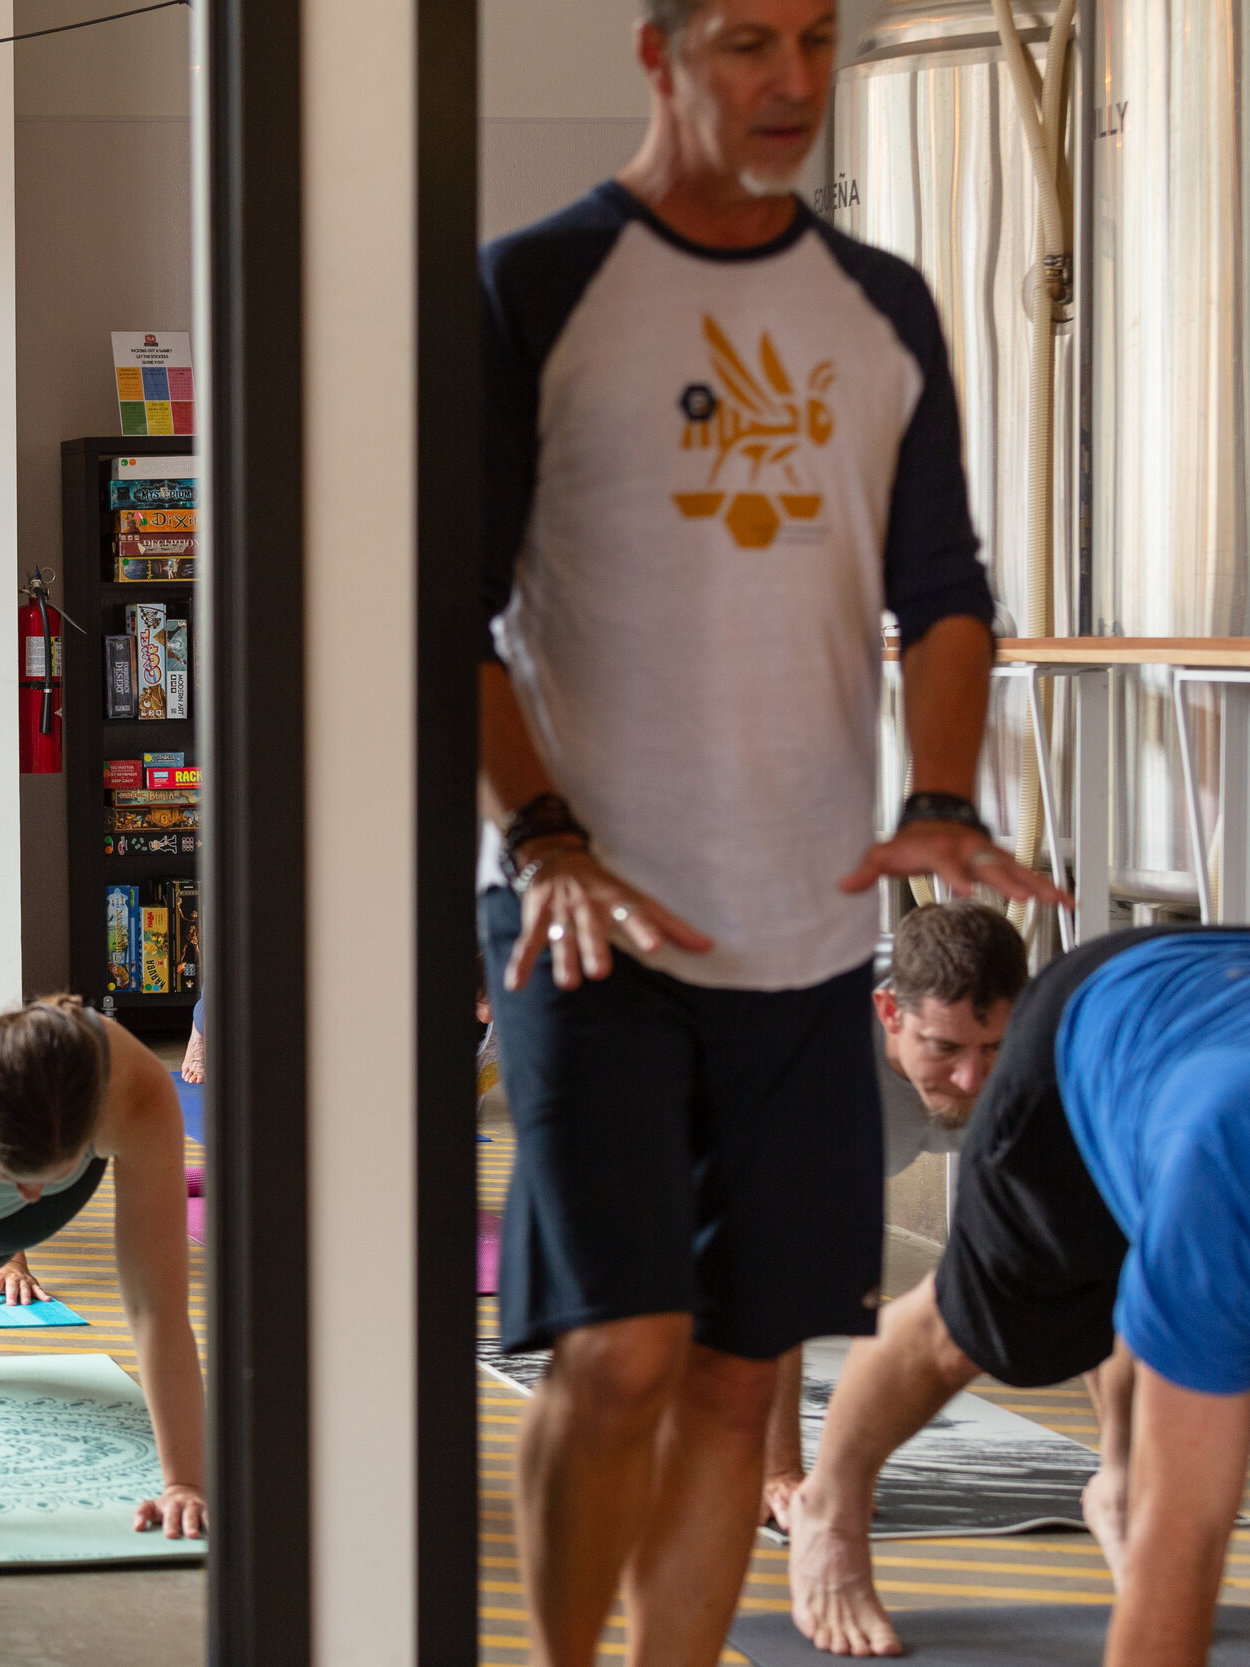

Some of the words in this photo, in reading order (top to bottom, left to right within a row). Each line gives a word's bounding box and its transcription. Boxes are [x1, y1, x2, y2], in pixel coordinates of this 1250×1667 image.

[115, 661, 124, 695] DESERT
[146, 791, 175, 803] IBERIA
[146, 960, 166, 990] KARUBA
